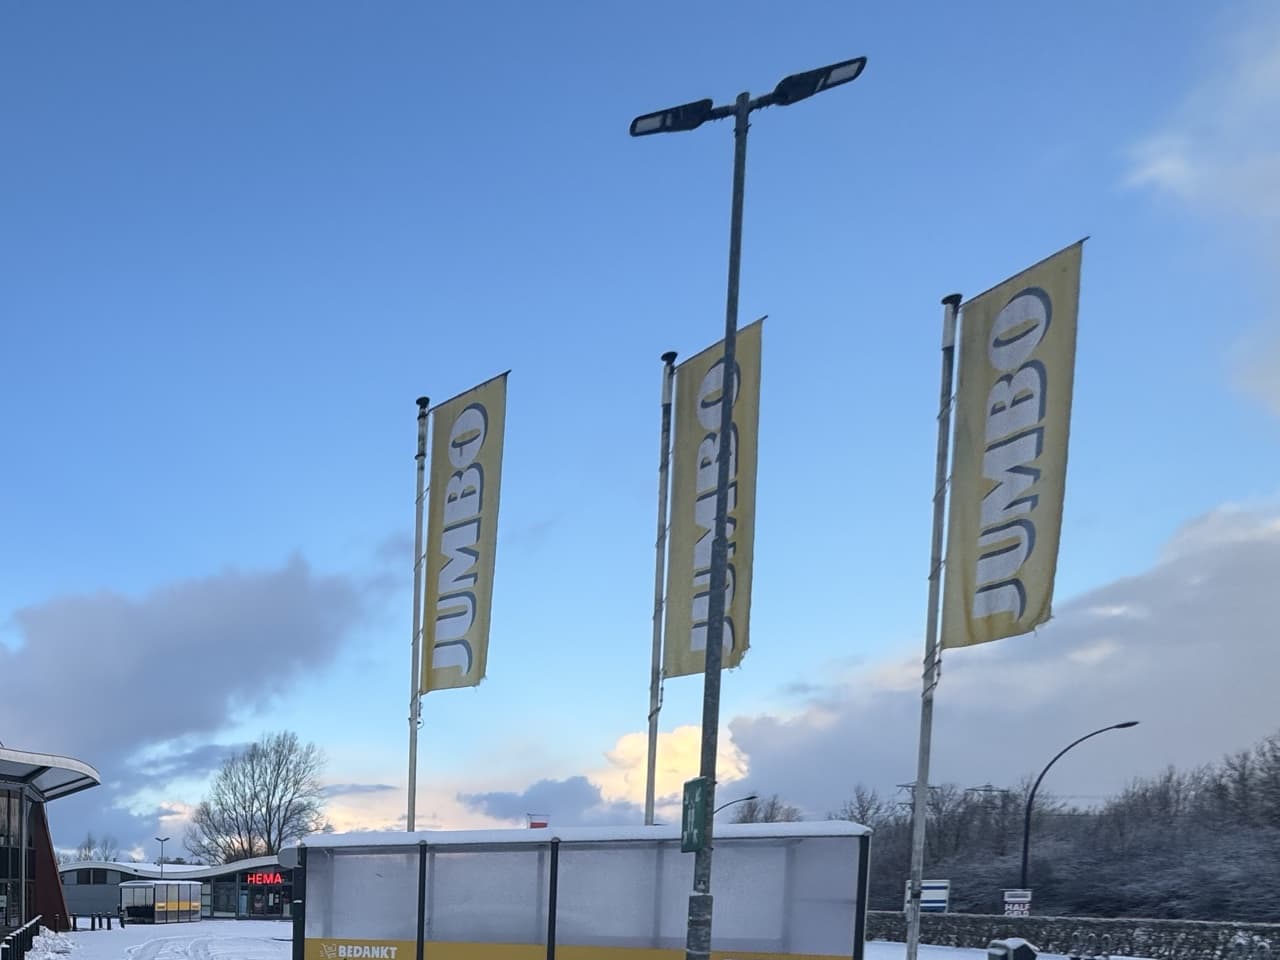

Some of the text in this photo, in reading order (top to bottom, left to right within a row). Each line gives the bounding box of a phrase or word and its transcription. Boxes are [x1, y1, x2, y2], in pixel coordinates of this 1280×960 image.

[972, 286, 1052, 624] JUMBO
[432, 401, 489, 677] JUMBO
[247, 873, 282, 885] HEMA
[338, 945, 398, 959] BEDANKT
